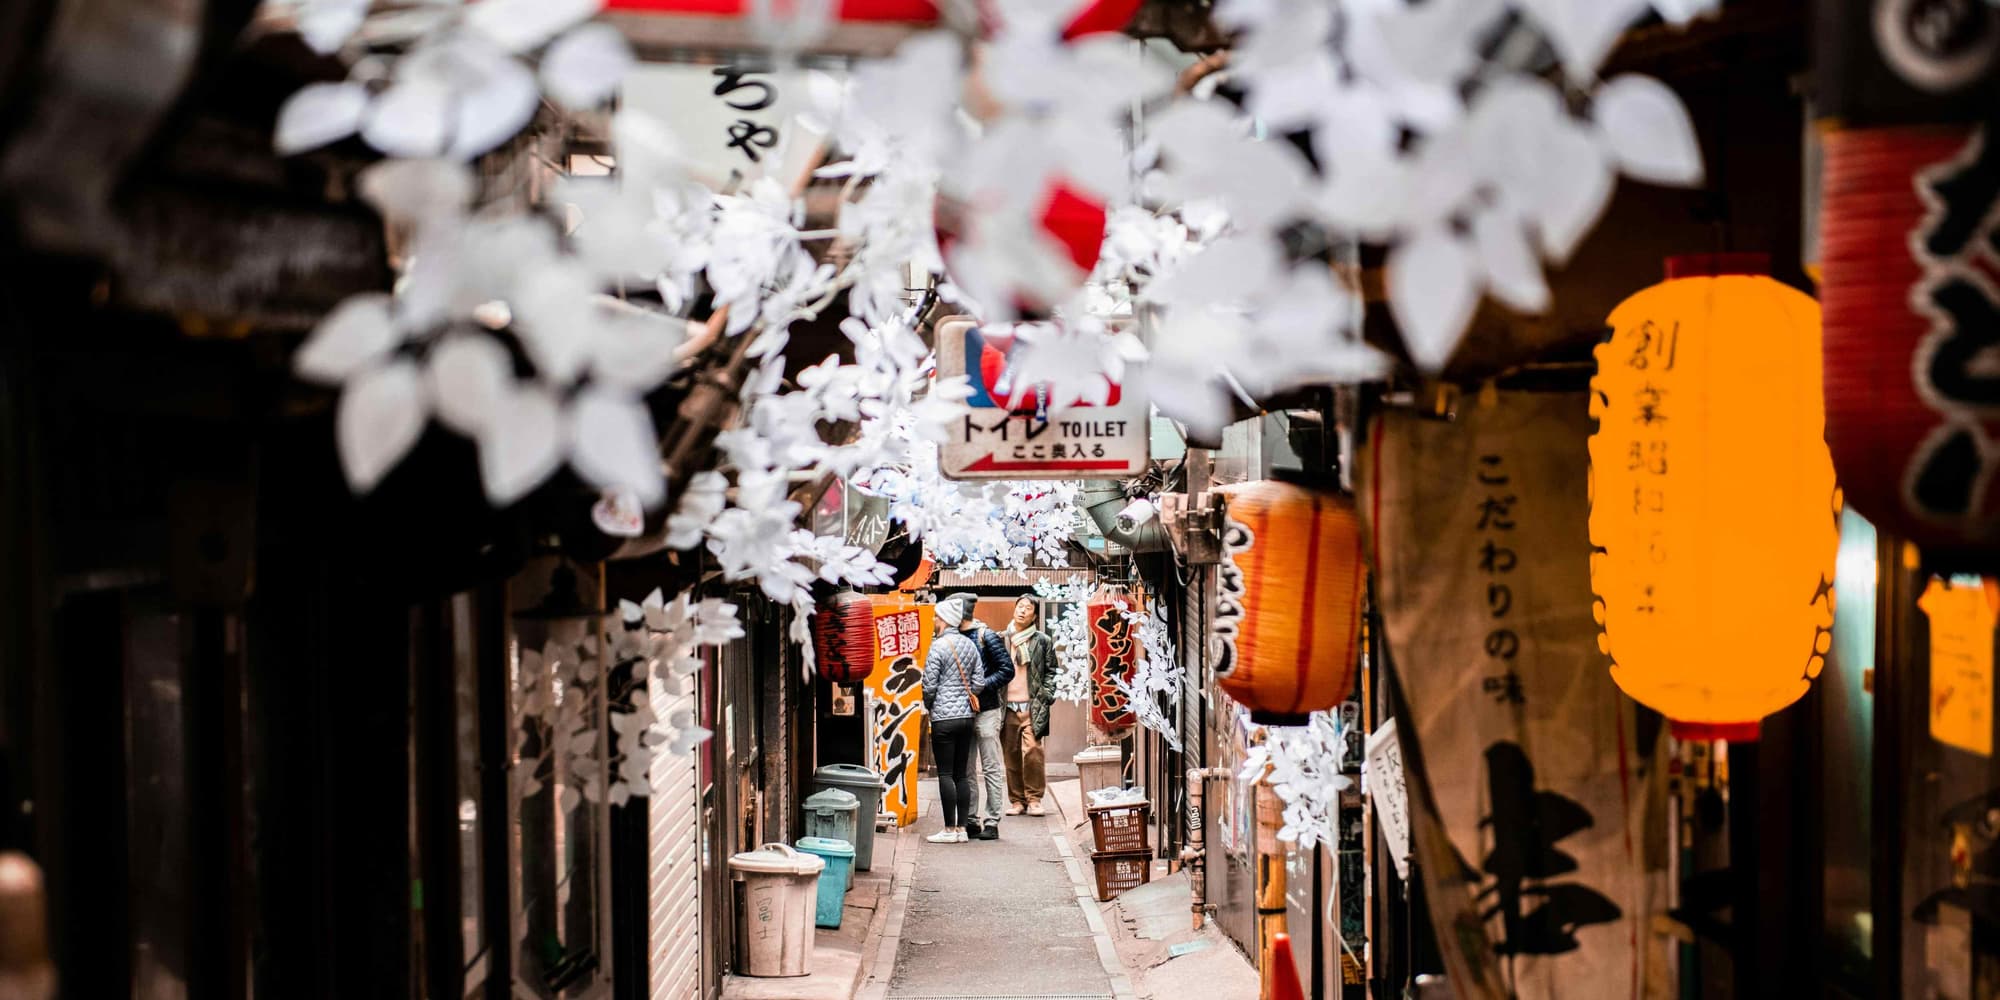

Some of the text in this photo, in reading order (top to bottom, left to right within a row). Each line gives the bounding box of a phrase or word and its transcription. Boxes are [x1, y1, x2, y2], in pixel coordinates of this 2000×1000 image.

[965, 414, 1127, 442] トイレ TOILET
[1012, 443, 1106, 459] ここ奥入る
[1476, 454, 1527, 708] こだわりの味
[884, 655, 923, 806] ランチ
